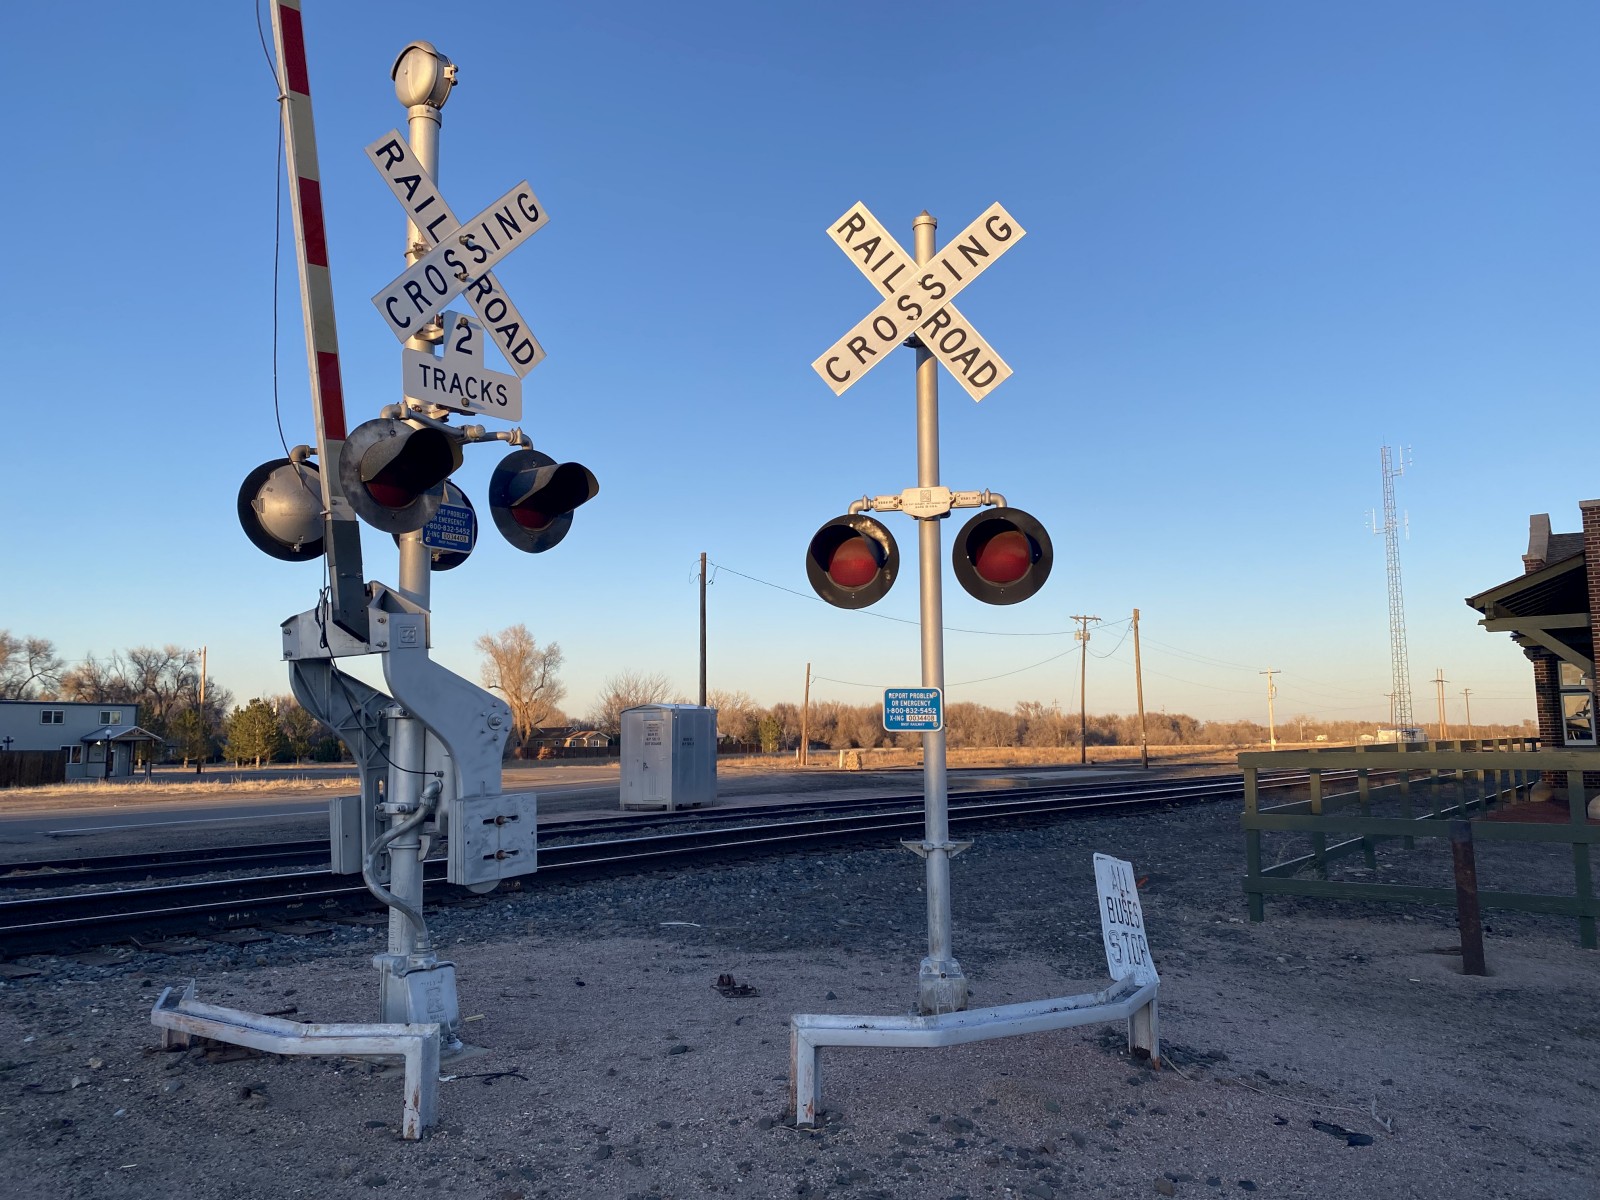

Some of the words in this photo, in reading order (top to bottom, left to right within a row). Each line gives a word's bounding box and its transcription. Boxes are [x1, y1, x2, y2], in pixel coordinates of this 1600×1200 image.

[375, 139, 447, 243] RAIL
[468, 274, 535, 366] ROAD
[385, 193, 539, 329] CROSSING
[825, 215, 1012, 383] CROSSING
[836, 212, 906, 294] RAIL
[921, 307, 998, 388] ROAD
[455, 324, 473, 355] 2
[418, 363, 508, 406] TRACKS
[426, 530, 440, 538] X-ING
[439, 517, 466, 526] EMERGENCY
[1110, 864, 1130, 894] ALL
[1106, 896, 1140, 929] BUSES
[1107, 929, 1147, 967] STOP
